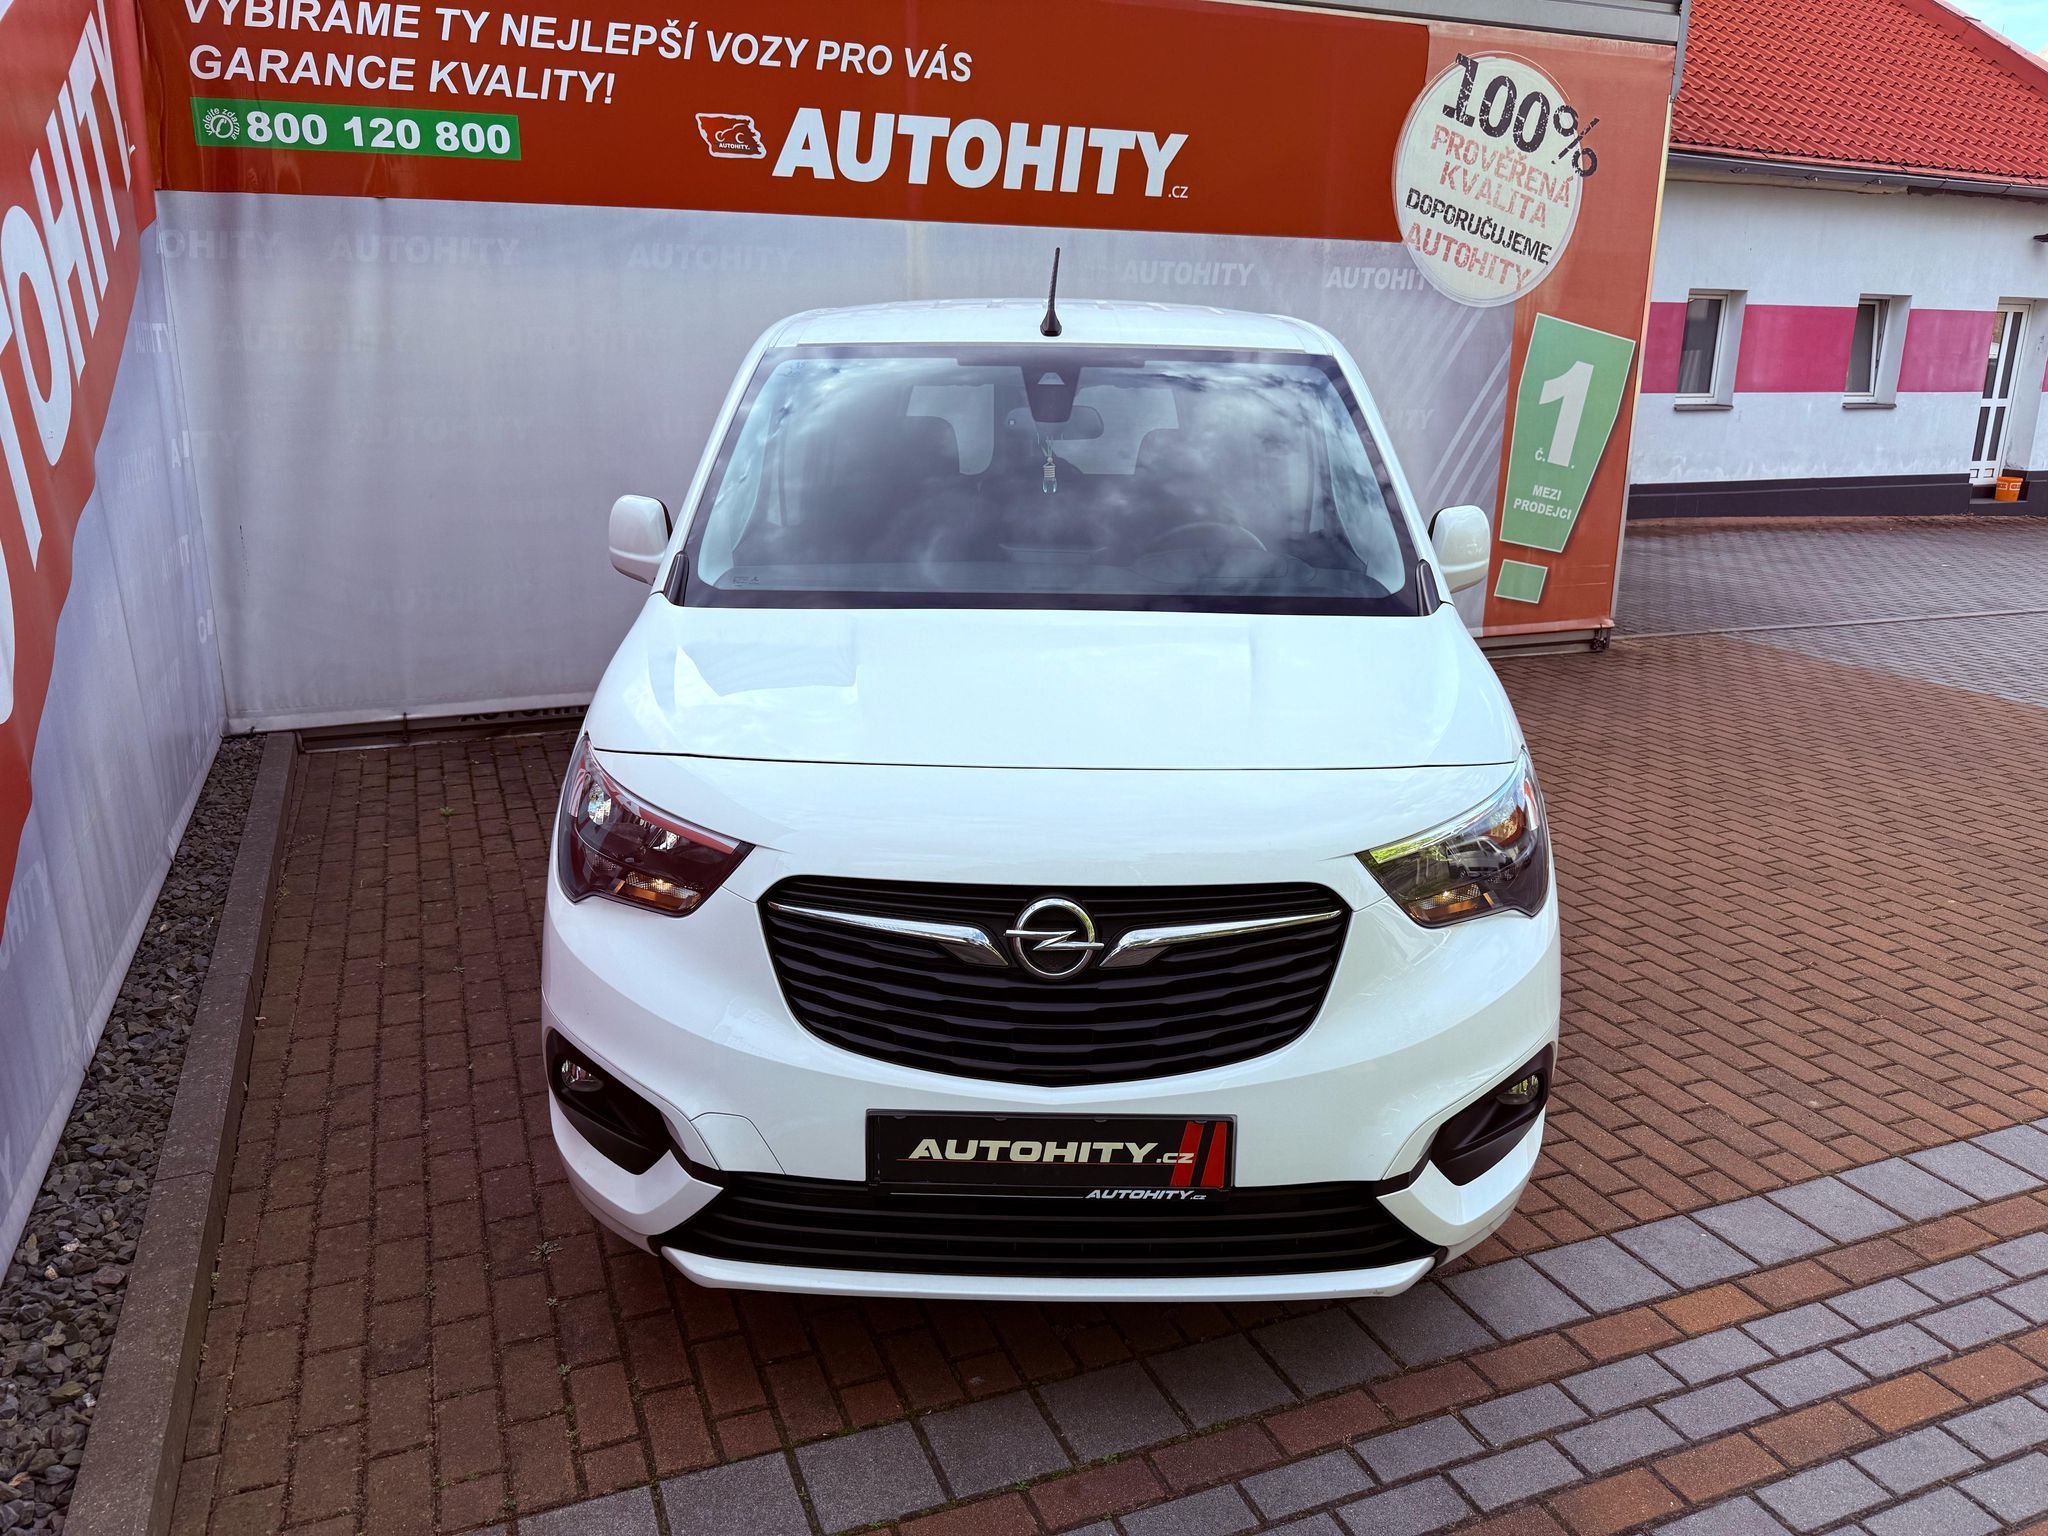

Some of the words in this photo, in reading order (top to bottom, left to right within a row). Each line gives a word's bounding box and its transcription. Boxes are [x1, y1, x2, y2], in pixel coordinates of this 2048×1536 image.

[435, 7, 490, 43] TY
[500, 13, 698, 60] NEJLEPŠÍ
[706, 30, 809, 69] VOZY
[816, 40, 893, 76] PRO
[904, 43, 973, 82] VÁS
[189, 44, 416, 91] GARANCE
[429, 59, 616, 104] KVALITY!
[202, 108, 221, 136] volejte
[221, 108, 240, 141] zdarma
[246, 110, 328, 145] 800
[343, 115, 421, 149] 120
[435, 121, 511, 154] 800
[1442, 53, 1600, 177] 100%
[1430, 123, 1574, 208] PROVĚŘENÁ
[1439, 161, 1546, 229] KVALITA
[329, 233, 520, 266] AUTOHITY
[1406, 187, 1552, 266] DOPORUČUJEME
[1121, 259, 1255, 288] AUTOHITY
[1325, 265, 1427, 292] AUTOHIT
[1404, 222, 1532, 292] AUTOHITY
[1513, 498, 1573, 521] PRODEJCI
[1532, 484, 1562, 502] MEZI
